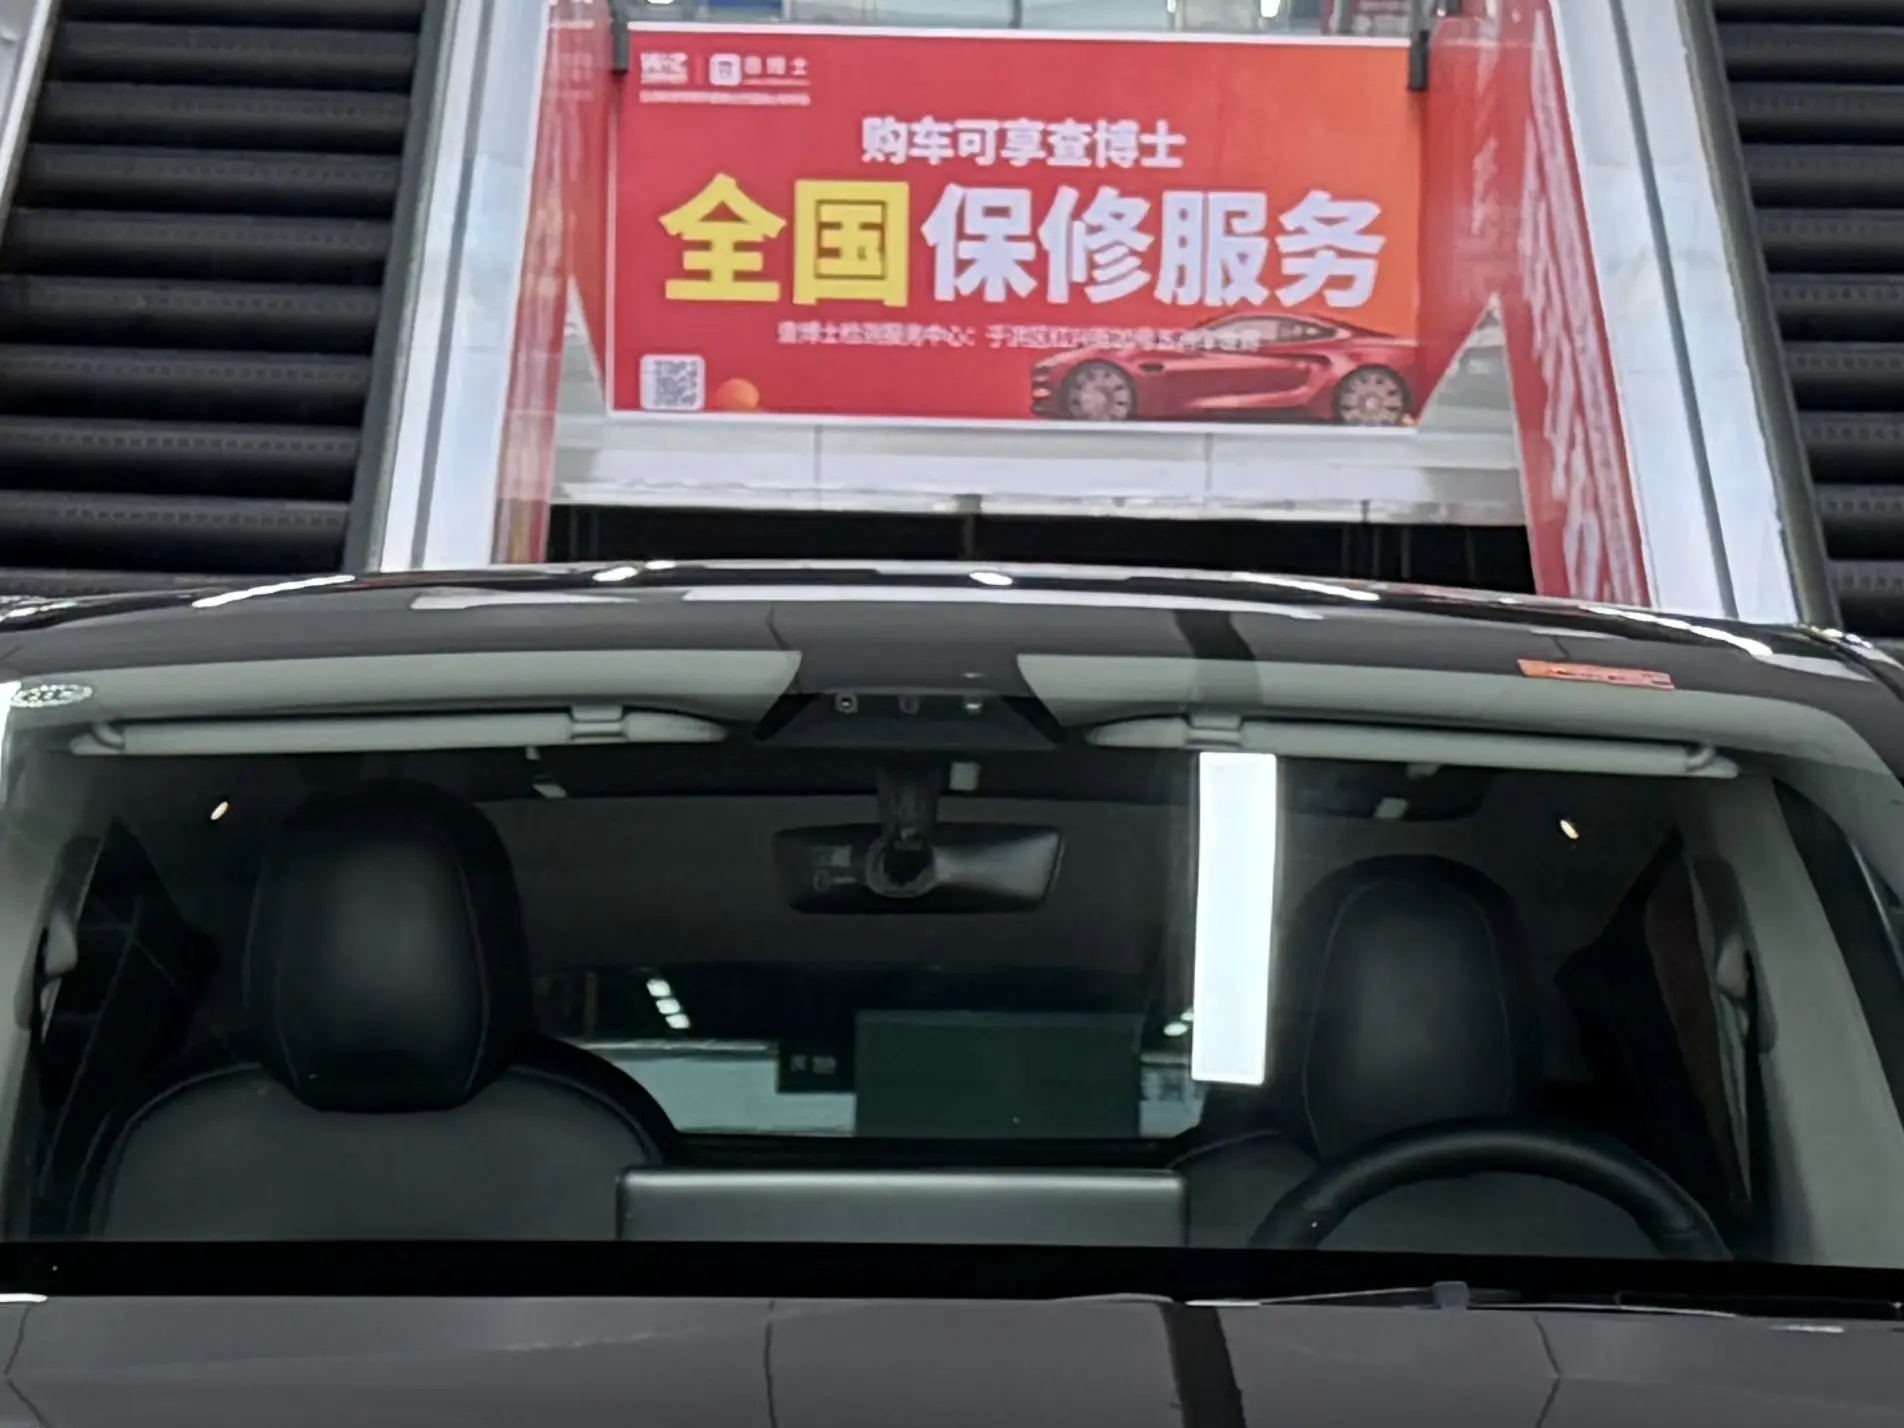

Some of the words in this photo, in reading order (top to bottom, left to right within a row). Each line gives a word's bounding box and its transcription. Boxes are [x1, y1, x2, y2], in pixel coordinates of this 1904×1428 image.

[861, 116, 1188, 169] 购车可享查博士
[658, 173, 1387, 308] 全国保修服务
